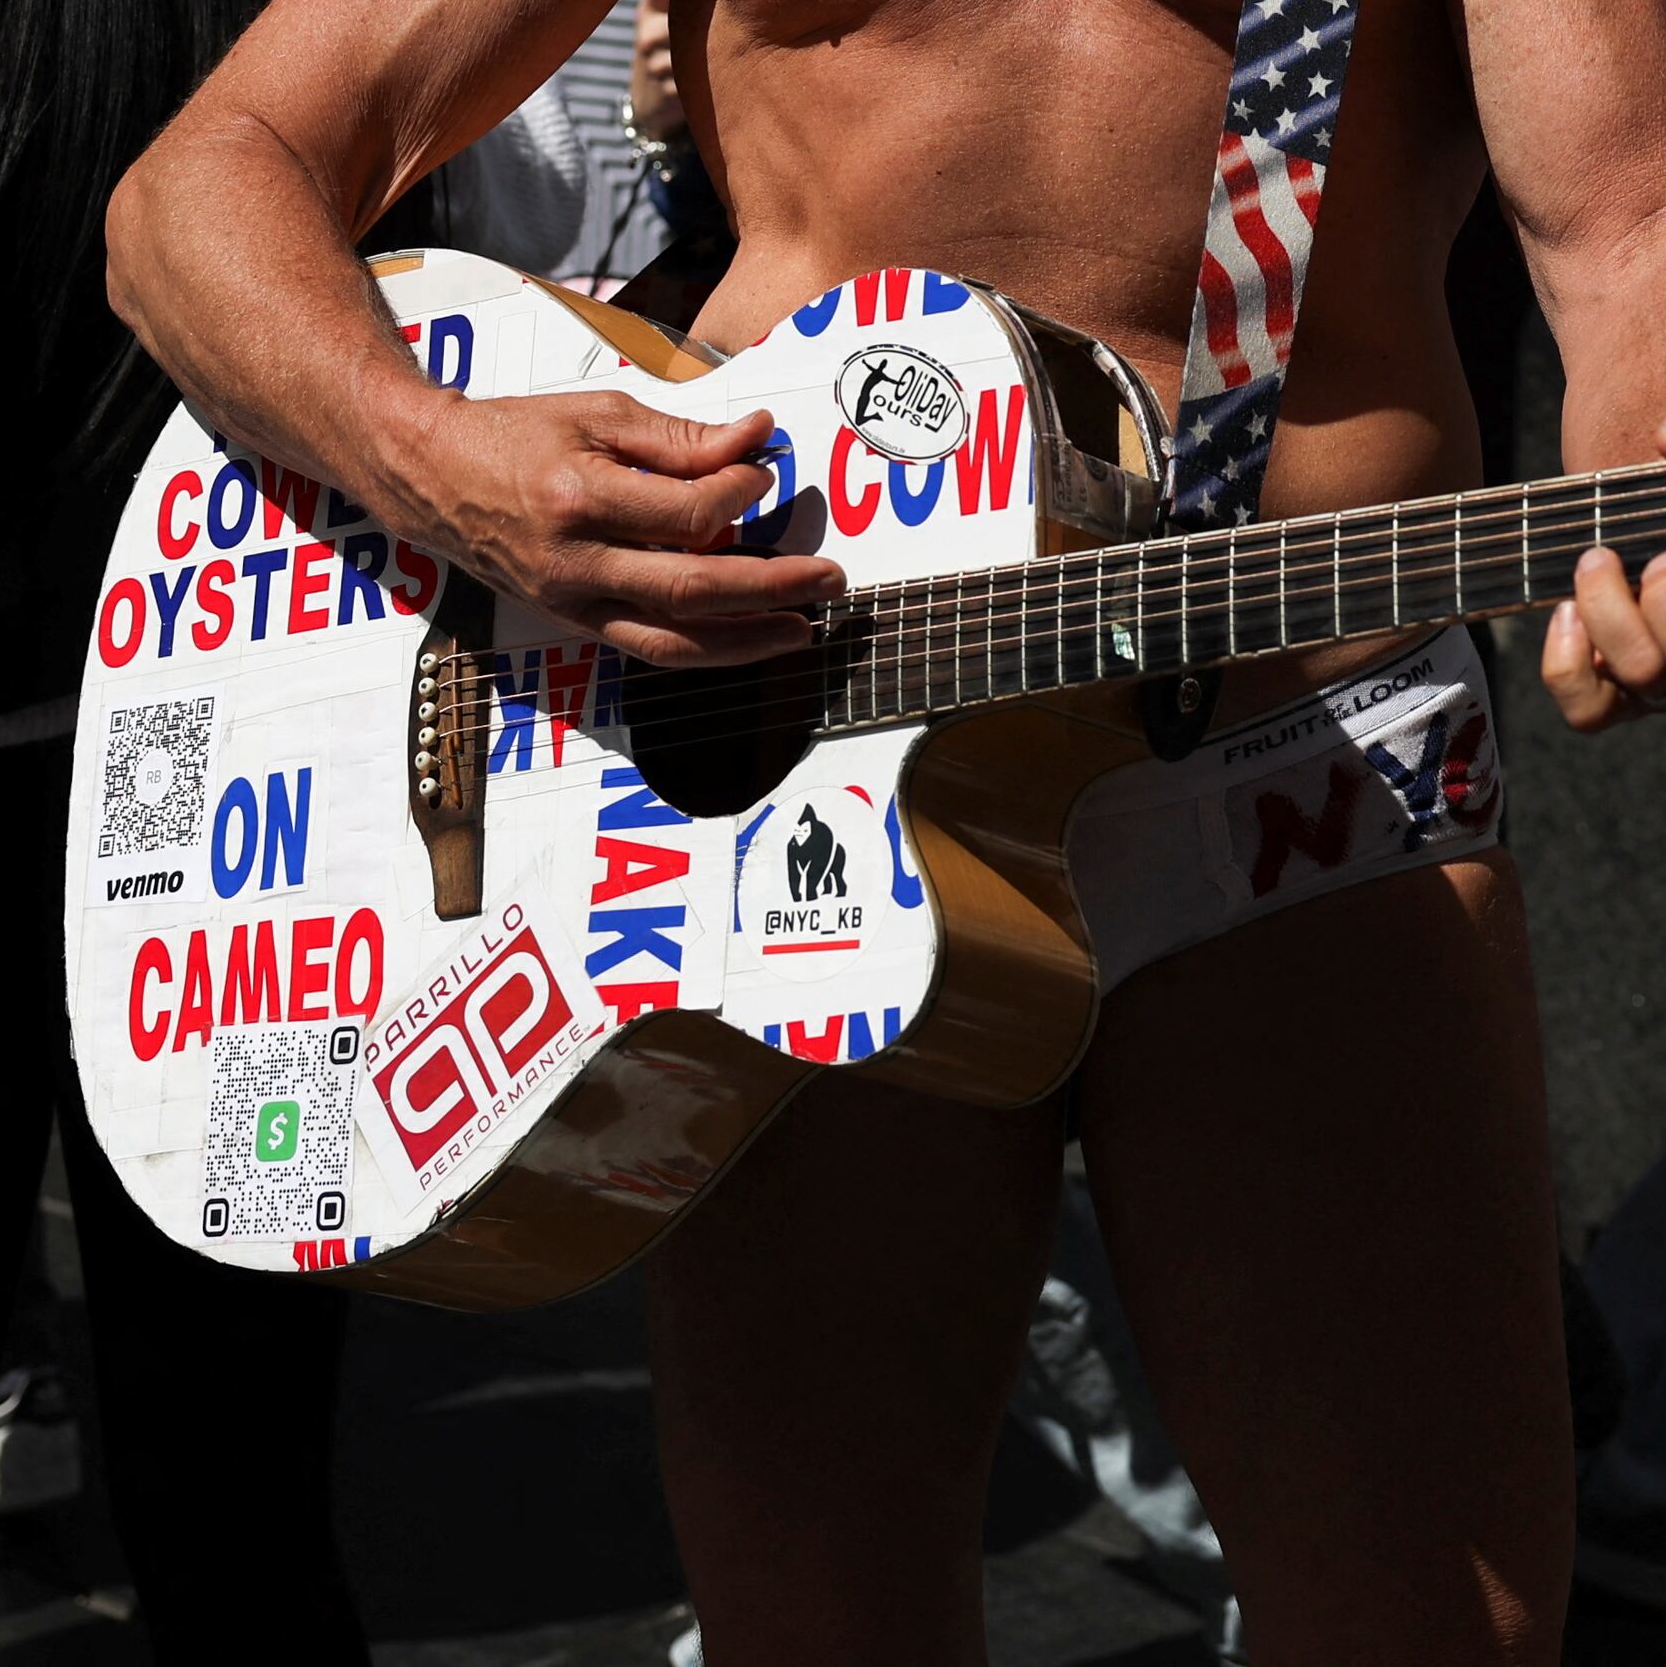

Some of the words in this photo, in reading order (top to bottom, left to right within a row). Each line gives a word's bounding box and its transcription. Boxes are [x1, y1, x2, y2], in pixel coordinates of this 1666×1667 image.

[98, 532, 440, 669] OYSTERS
[1224, 714, 1317, 765] FRUIT
[1354, 658, 1435, 713] LOOM
[107, 870, 184, 902] venmo
[211, 766, 312, 900] ON
[128, 907, 384, 1061] CAMEO
[765, 906, 863, 935] @NYC_KB
[366, 904, 524, 1073] PARRILLO
[419, 1023, 586, 1191] PERFORMANCE
